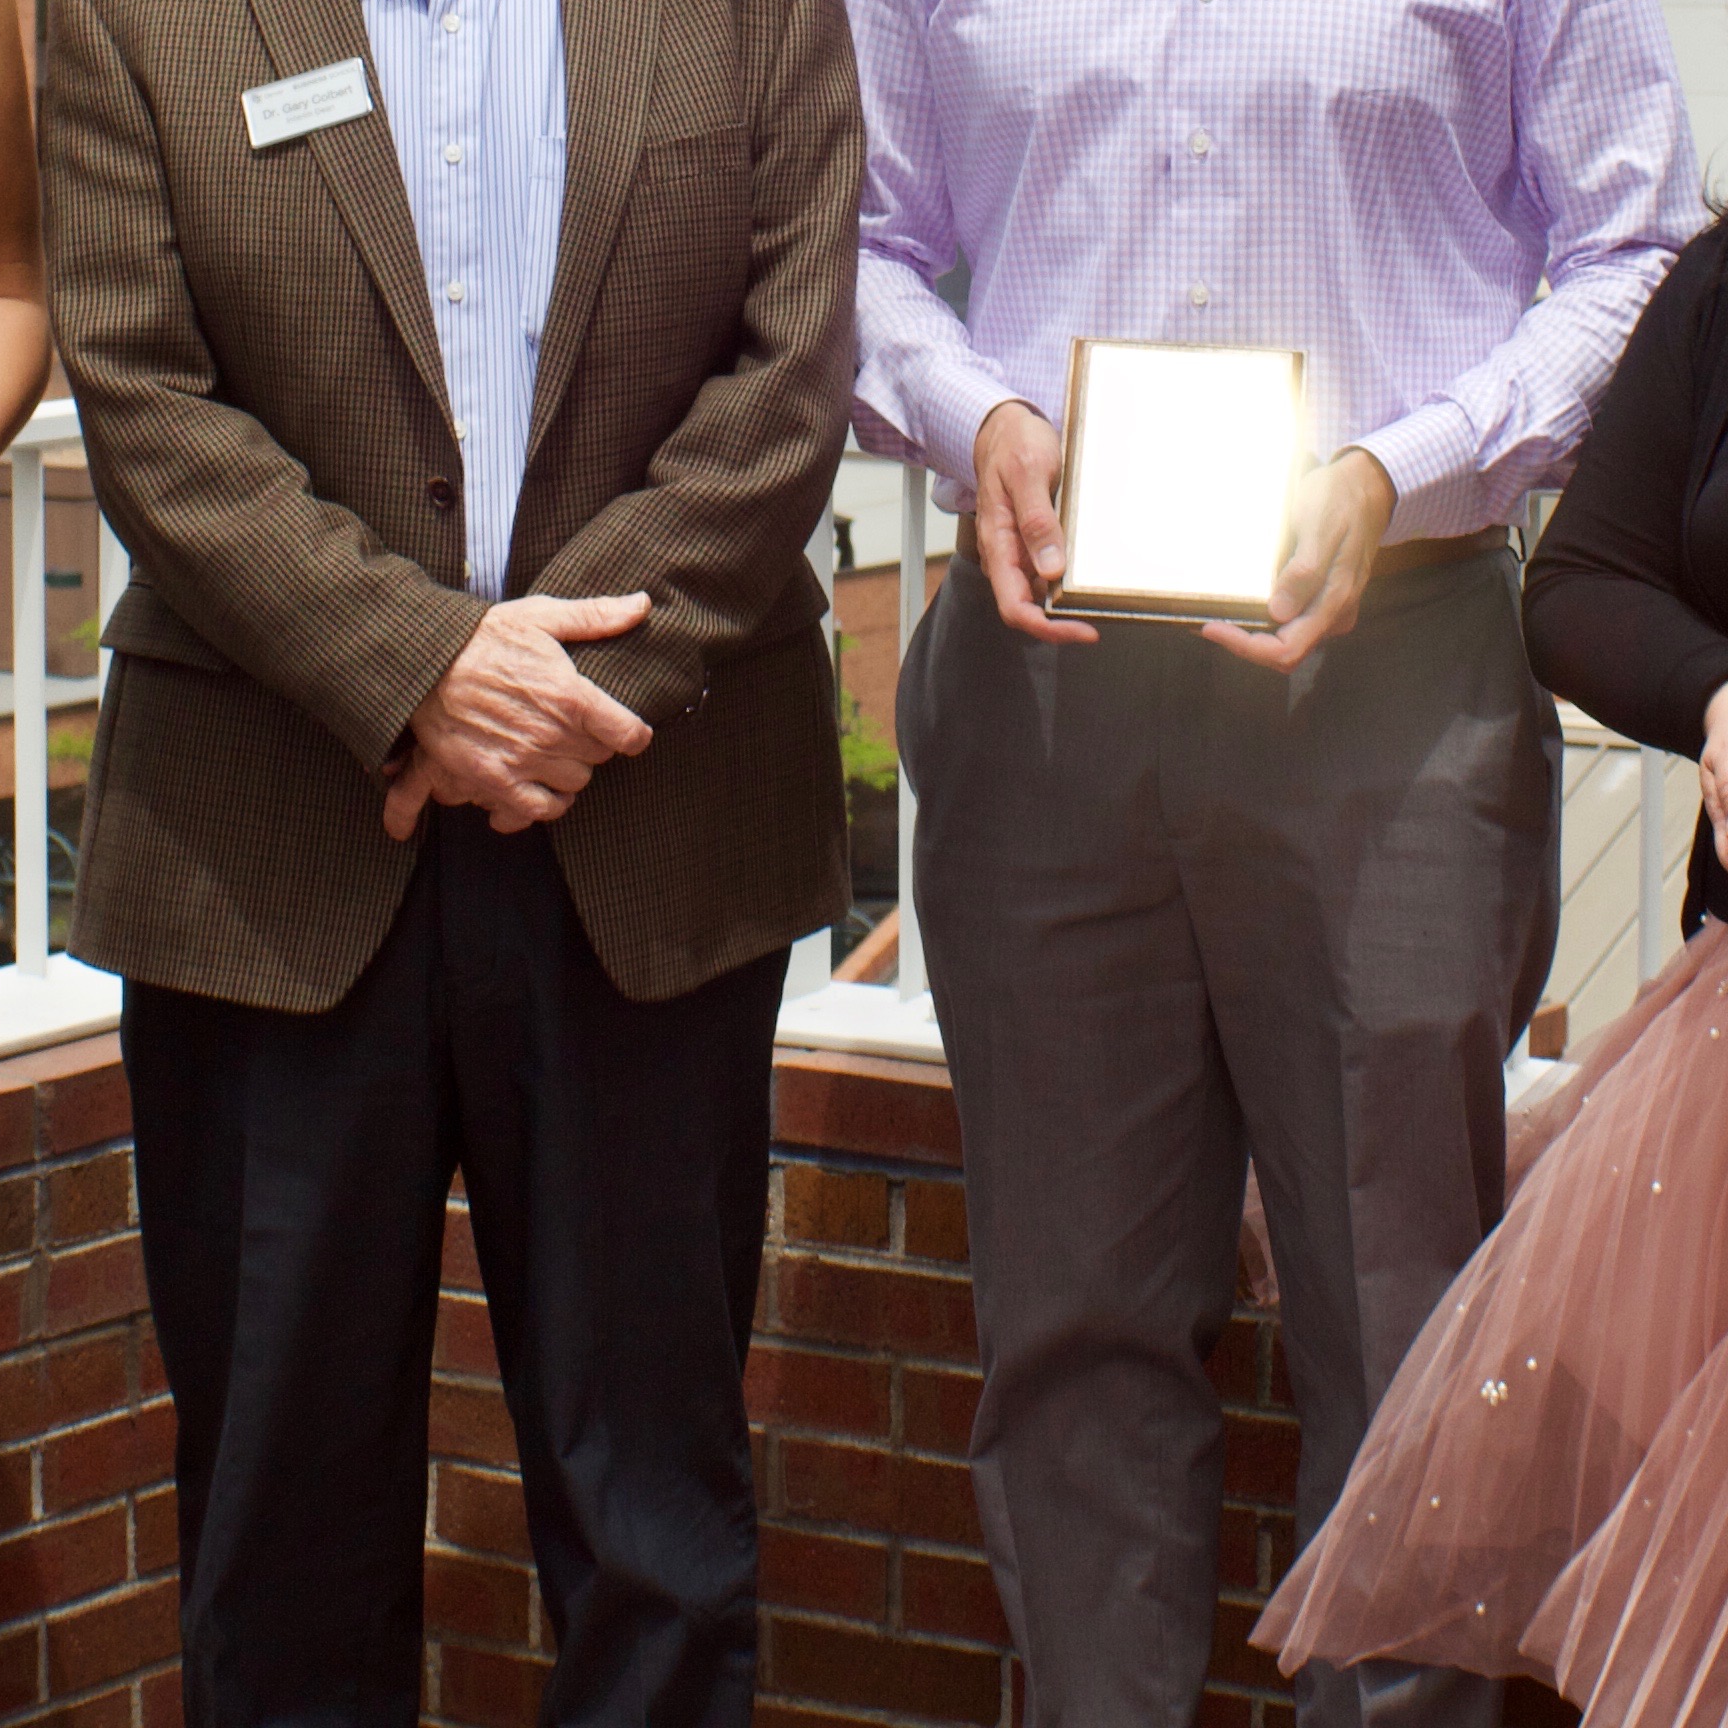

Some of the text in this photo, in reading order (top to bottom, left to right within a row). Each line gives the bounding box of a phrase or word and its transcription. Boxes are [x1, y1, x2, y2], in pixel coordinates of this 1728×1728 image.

[263, 85, 353, 120] Dr. Gary Colbert
